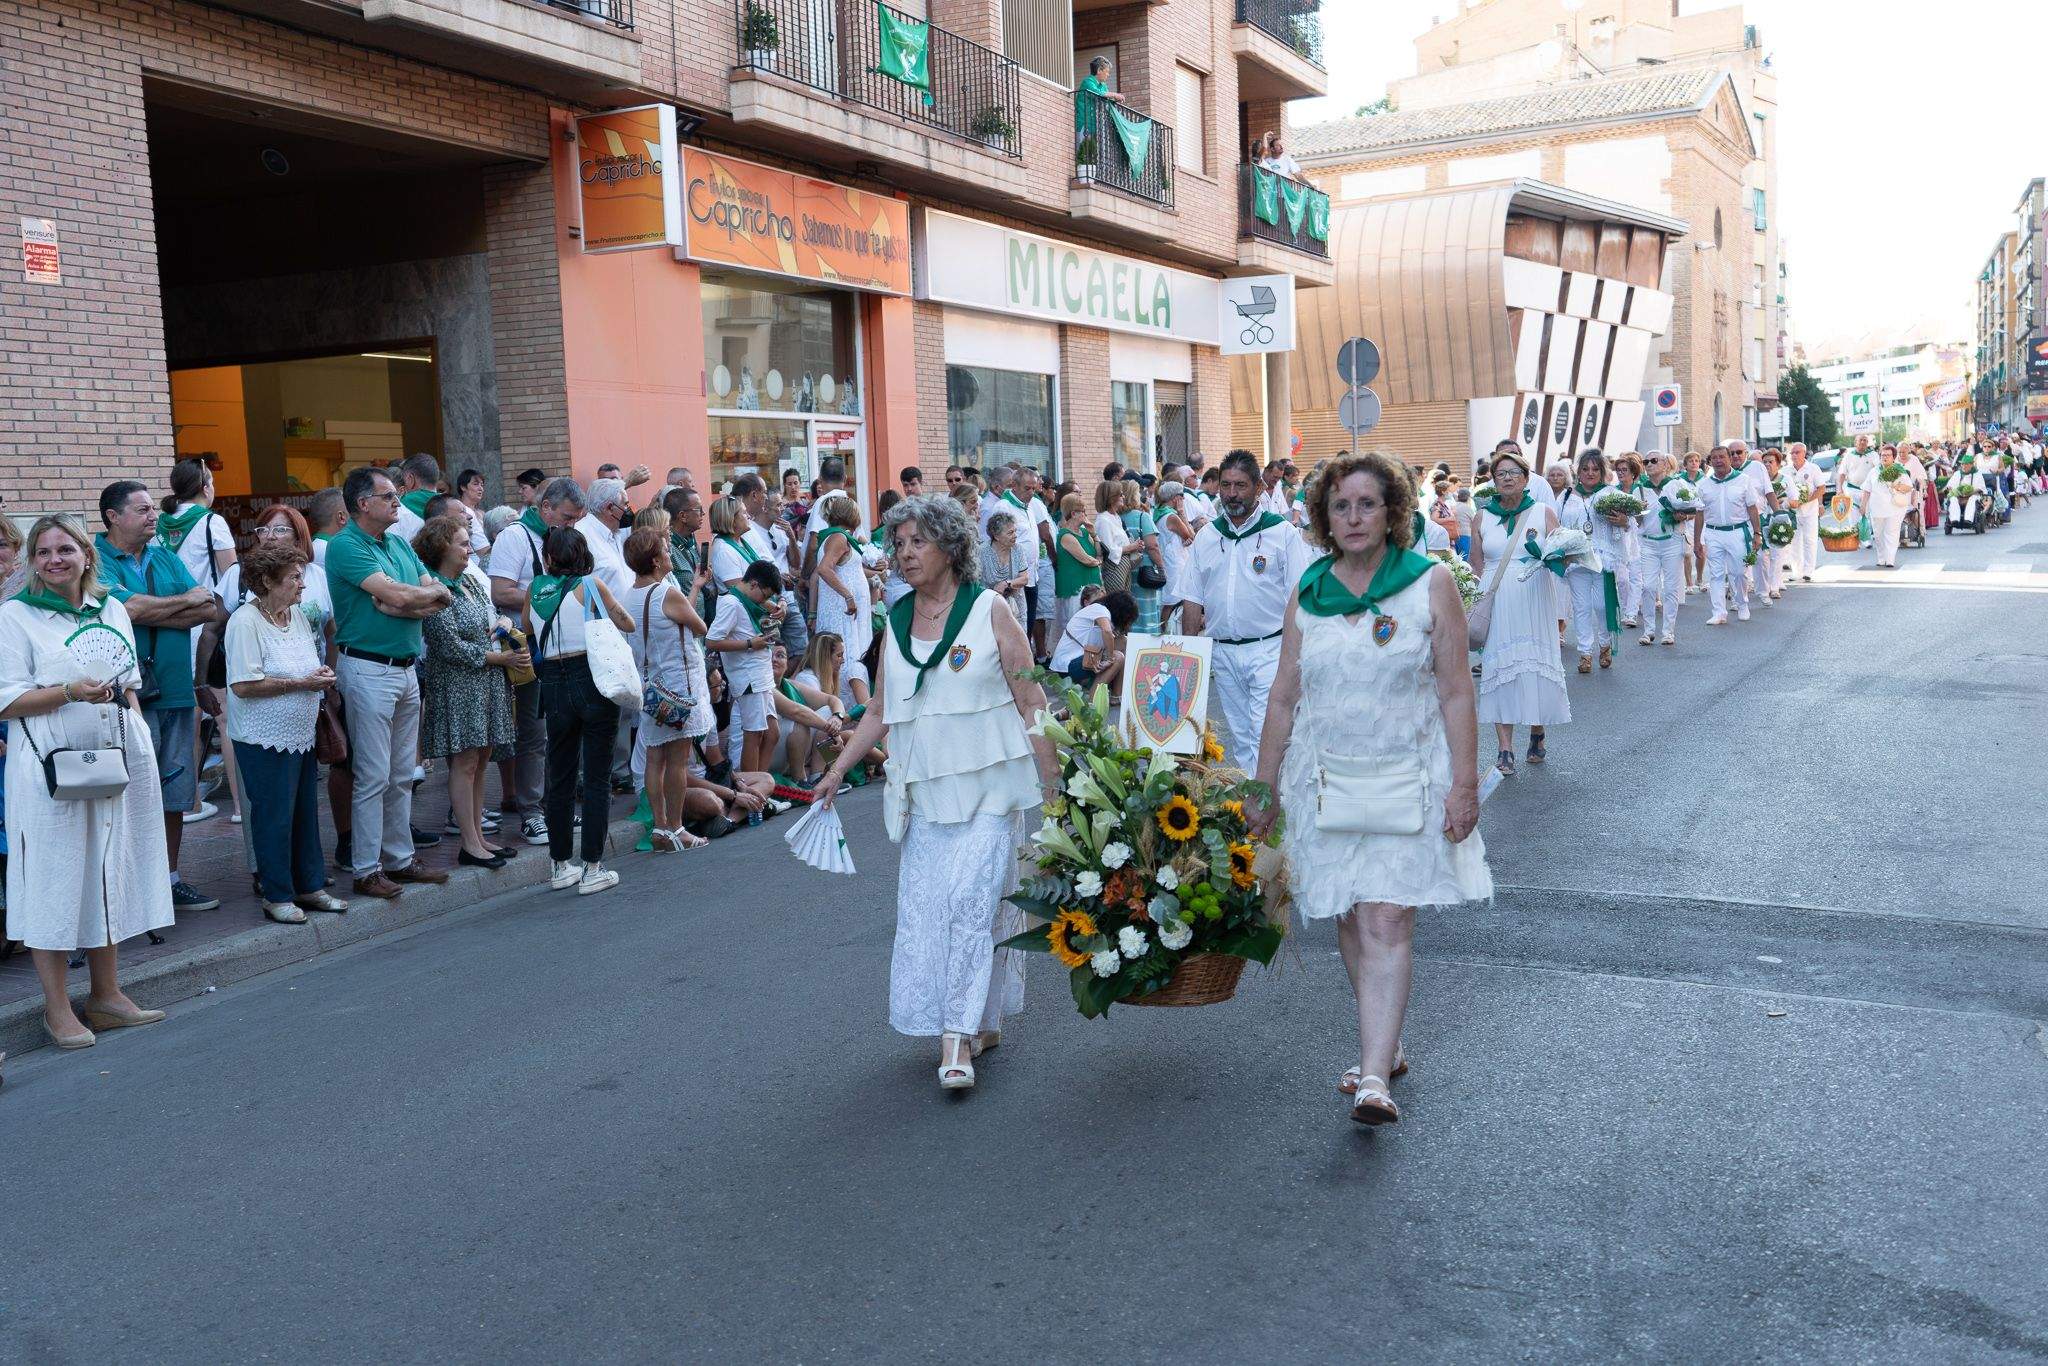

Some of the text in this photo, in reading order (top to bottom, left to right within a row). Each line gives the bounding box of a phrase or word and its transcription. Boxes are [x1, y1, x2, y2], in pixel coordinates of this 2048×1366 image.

[580, 154, 662, 187] Capricho
[688, 178, 793, 241] Capricho
[24, 229, 55, 238] verisure
[25, 244, 57, 255] Alarma
[802, 213, 843, 249] Sabemos
[854, 230, 869, 257] que
[870, 229, 881, 256] te
[1009, 238, 1171, 328] MICAELA
